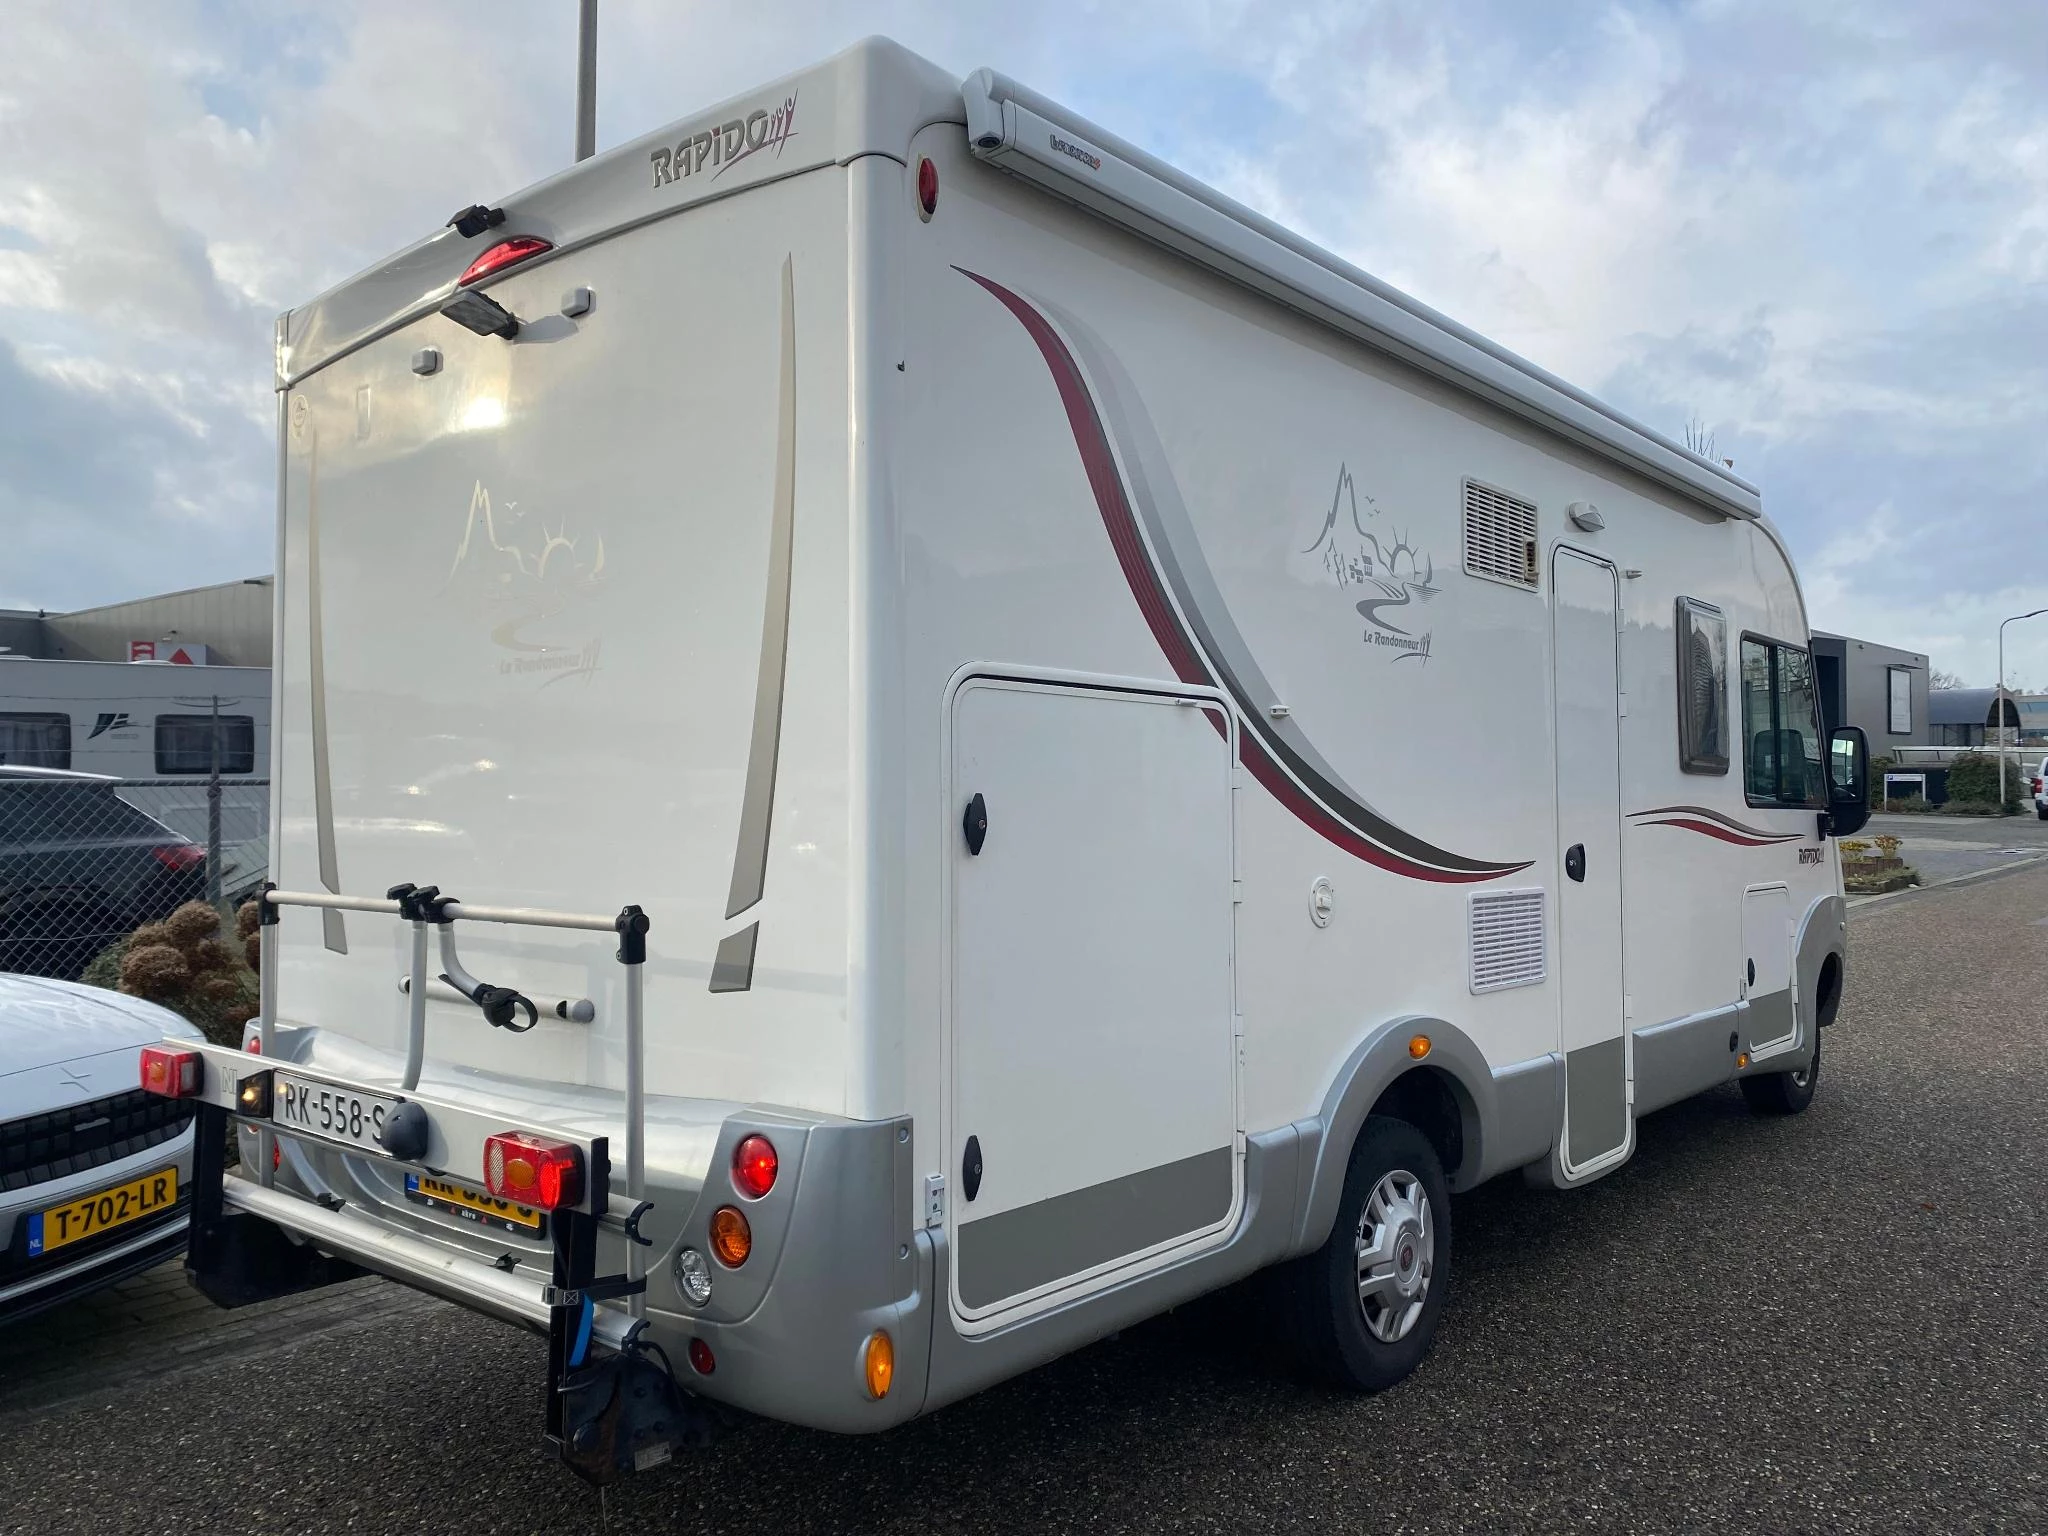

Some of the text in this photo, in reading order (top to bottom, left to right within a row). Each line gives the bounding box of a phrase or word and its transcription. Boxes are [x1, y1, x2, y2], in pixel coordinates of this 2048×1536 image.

[1363, 629, 1373, 643] Le
[285, 1081, 385, 1145] RK-558-S
[56, 1177, 168, 1240] T-702-LR
[29, 1238, 42, 1249] NL
